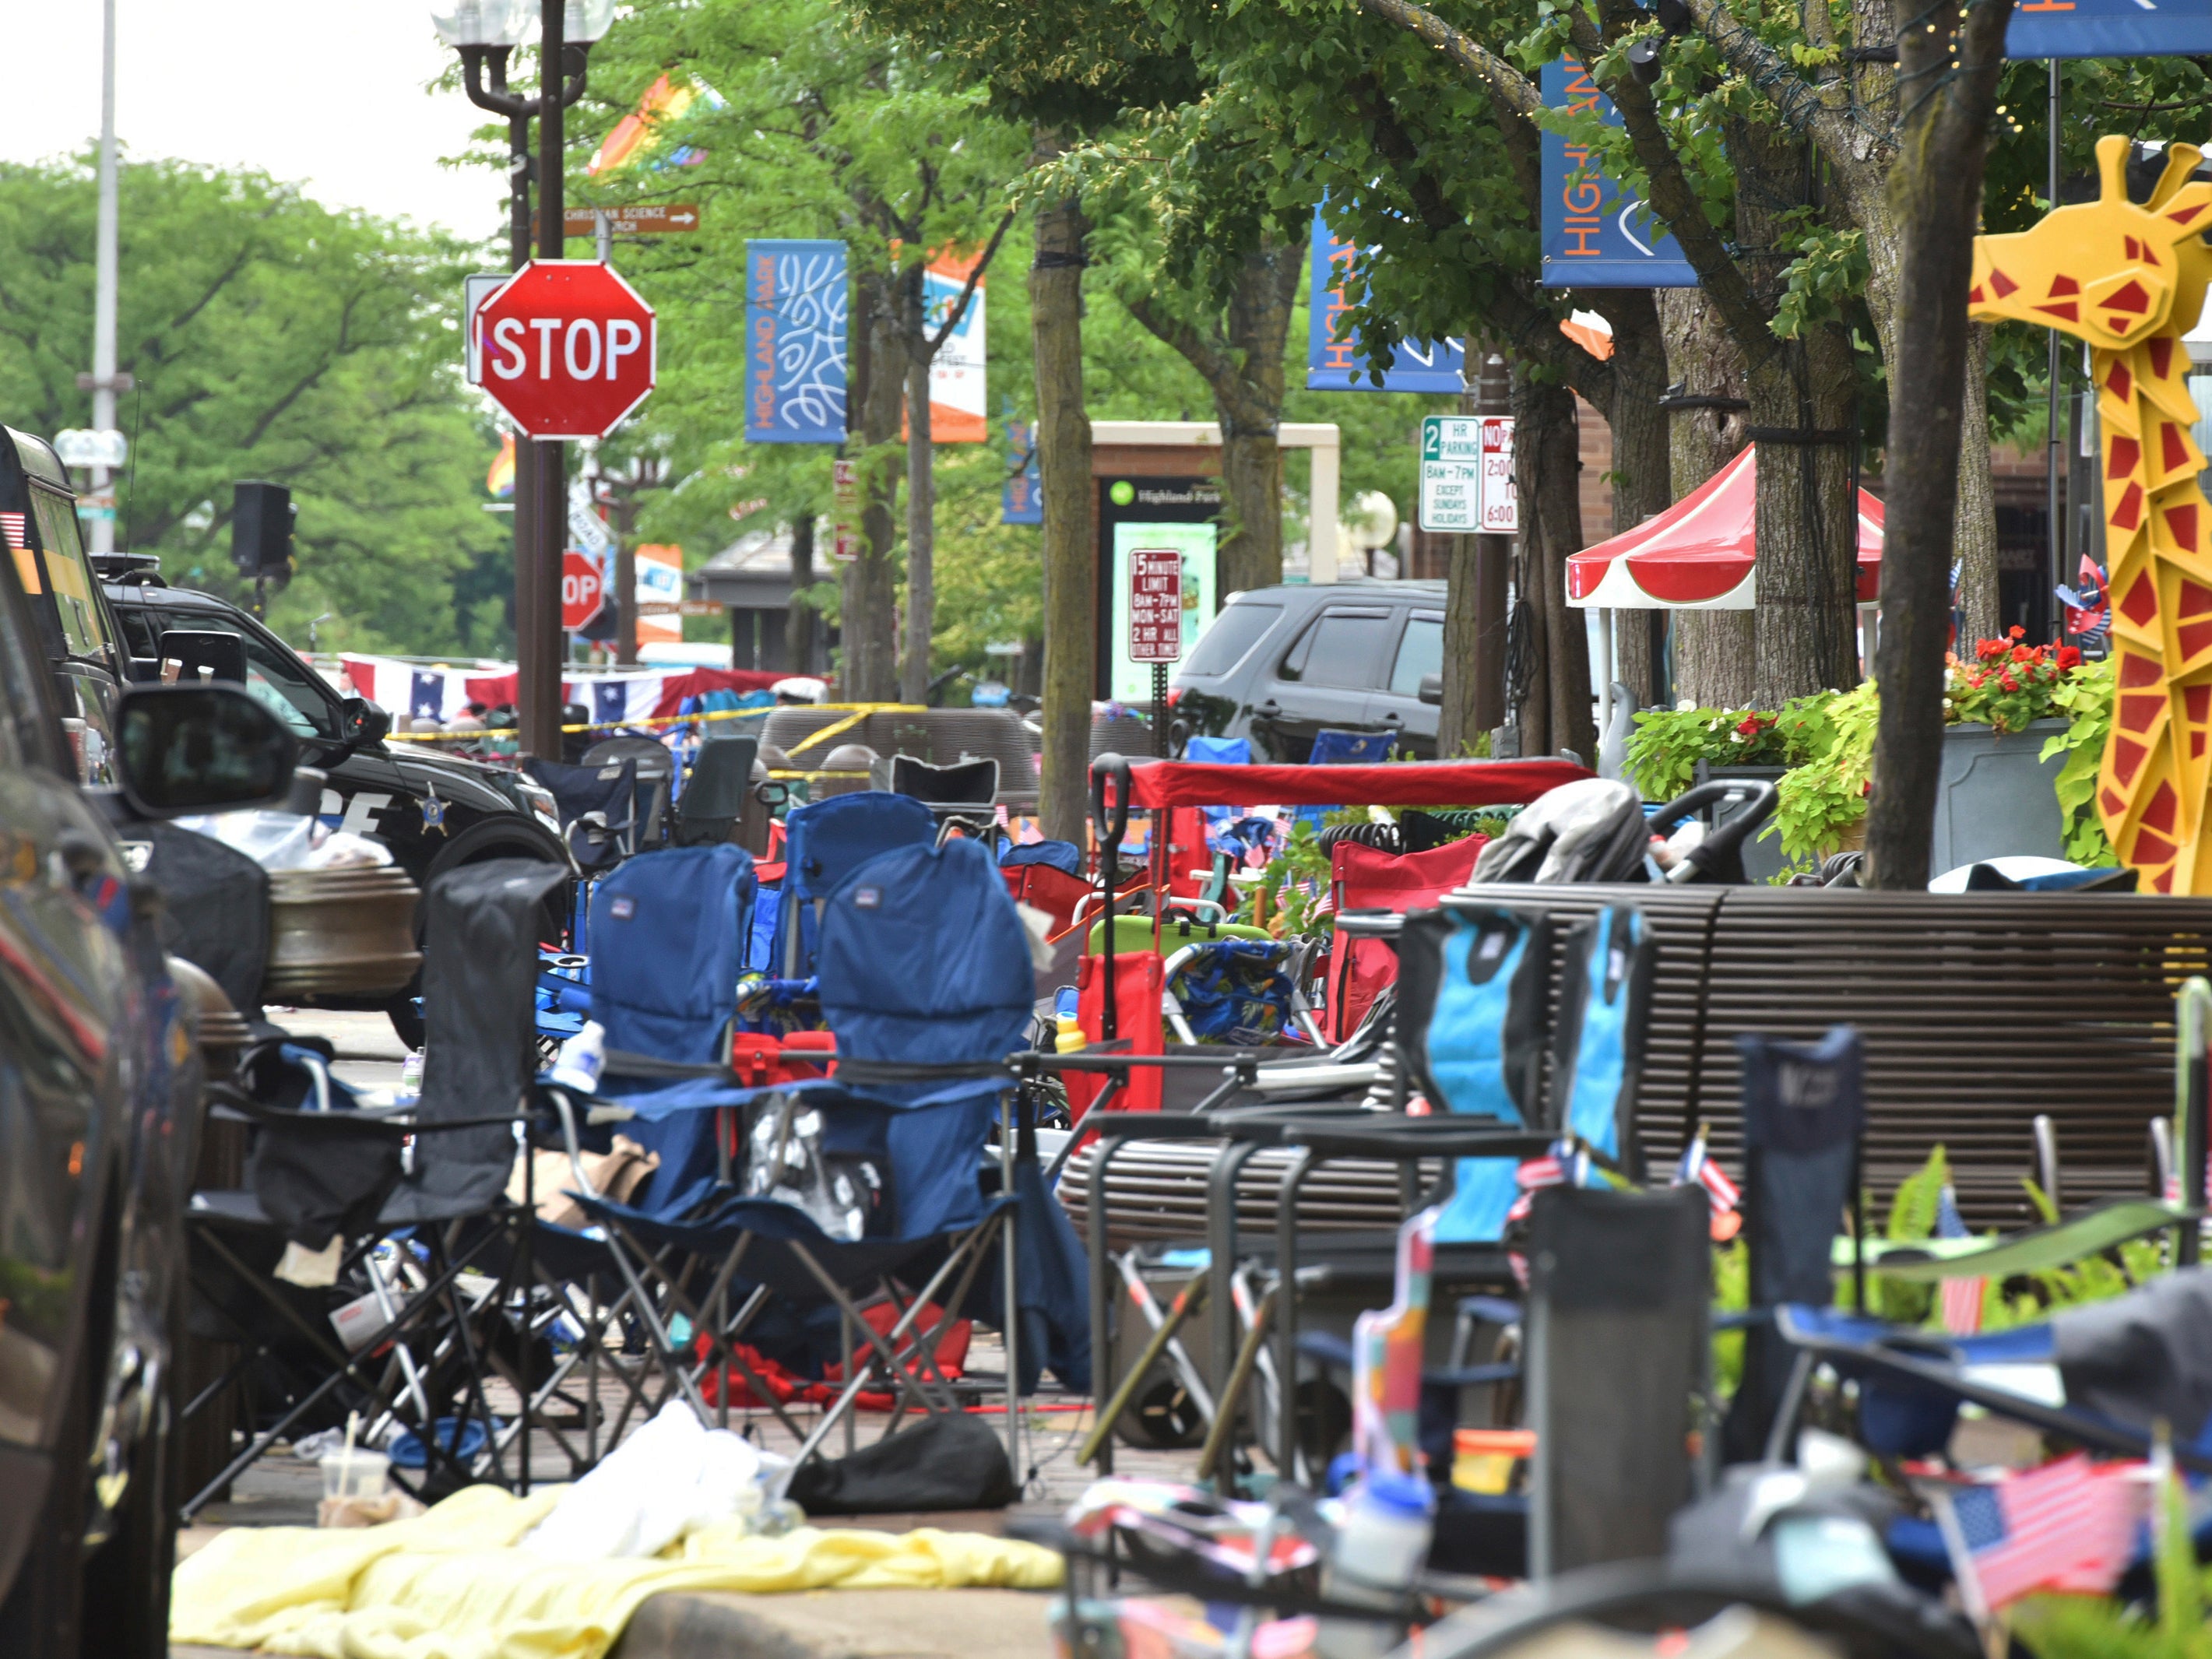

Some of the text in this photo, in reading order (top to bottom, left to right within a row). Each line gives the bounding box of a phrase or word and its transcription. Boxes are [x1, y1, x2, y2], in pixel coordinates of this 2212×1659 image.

[1563, 53, 1601, 255] HIGHAN
[564, 207, 666, 221] CHRISAN SCIENCE
[491, 317, 642, 381] STOP
[755, 316, 775, 429] HIGHLAND
[1426, 424, 1468, 452] 2 HR
[1484, 426, 1500, 447] NO
[1441, 441, 1478, 455] PARKING
[1488, 459, 1513, 476] 2:00
[1138, 490, 1222, 504] Highland Park
[1437, 485, 1464, 495] EXCEPT
[1433, 499, 1467, 509] SUNDAYS
[1433, 513, 1468, 523] HOLIDAYS
[1488, 506, 1514, 522] 6:00
[1132, 554, 1178, 575] 15 MINUTE
[562, 575, 598, 605] OP
[1141, 577, 1169, 592] LIMIT
[1133, 627, 1177, 641] 2 HR ALL
[1132, 643, 1156, 656] OTHER
